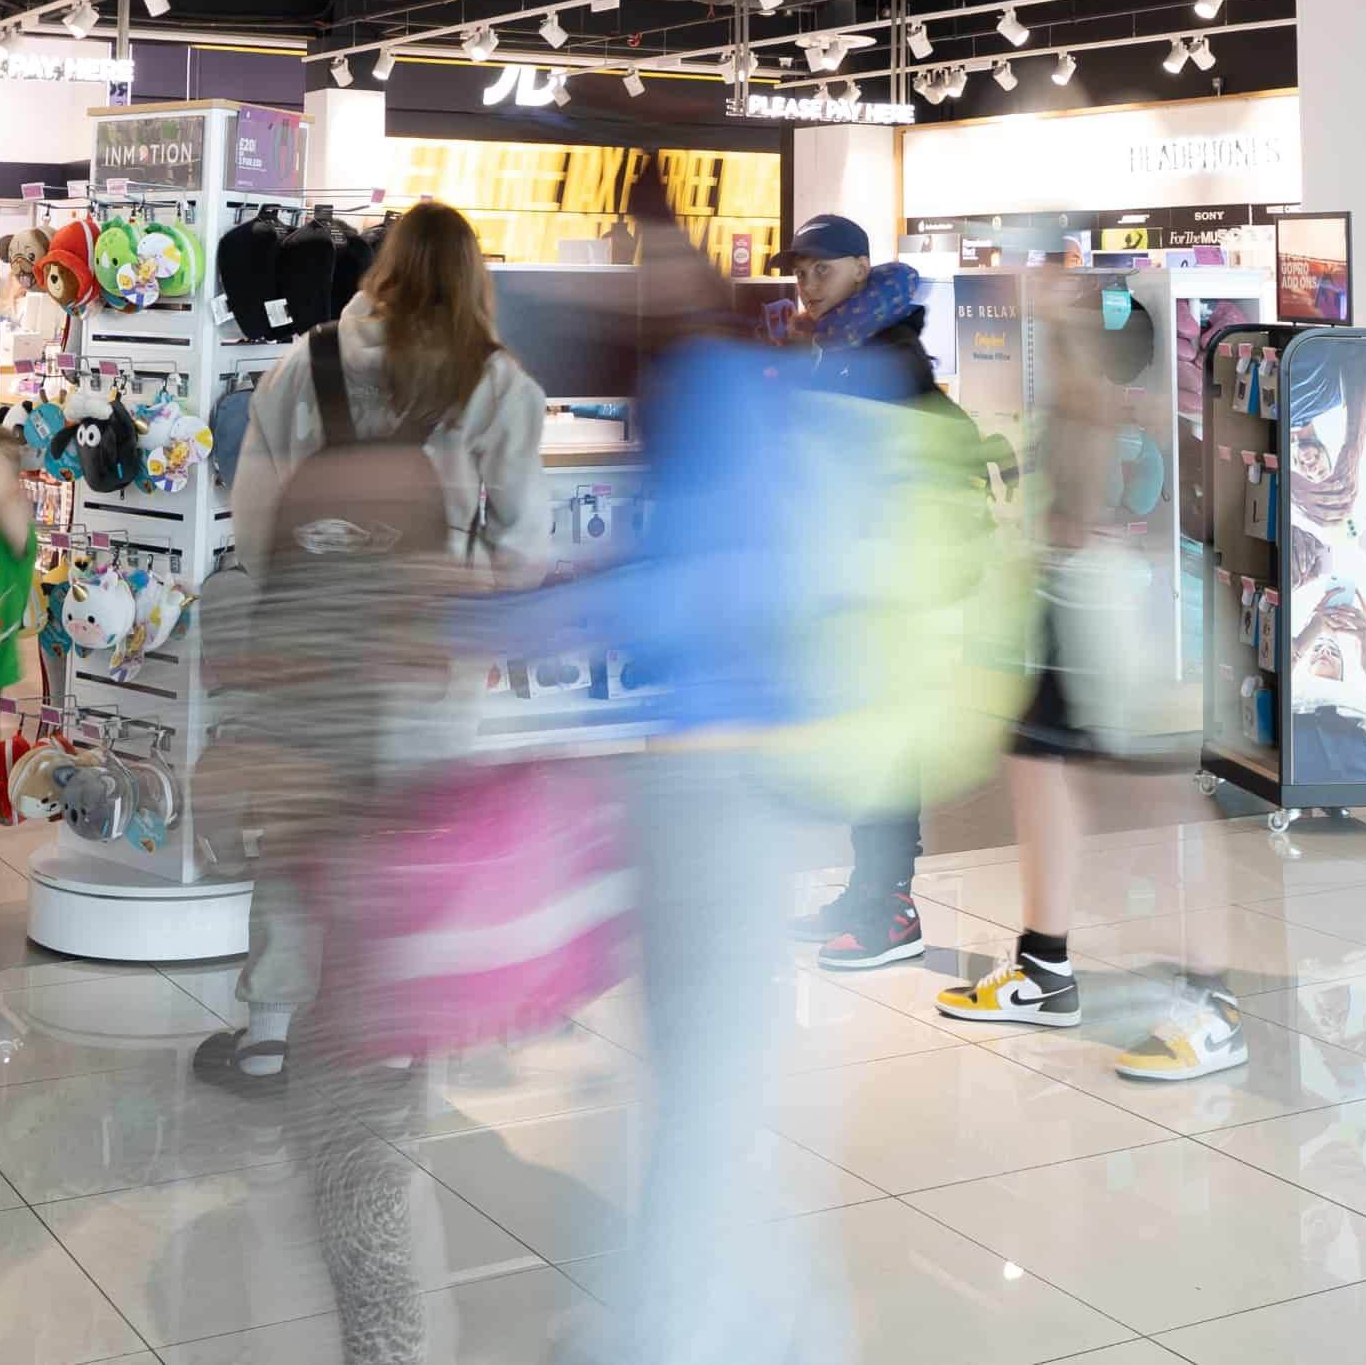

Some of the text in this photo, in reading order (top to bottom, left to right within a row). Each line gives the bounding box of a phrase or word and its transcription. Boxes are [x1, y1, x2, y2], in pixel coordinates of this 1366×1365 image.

[63, 56, 134, 83] HERE
[748, 93, 916, 124] PLEASE PAY HERE
[105, 142, 193, 166] INMOTION
[1130, 137, 1283, 173] HEADPHONES
[1194, 211, 1225, 221] SONY
[958, 305, 1018, 318] BE RELAX
